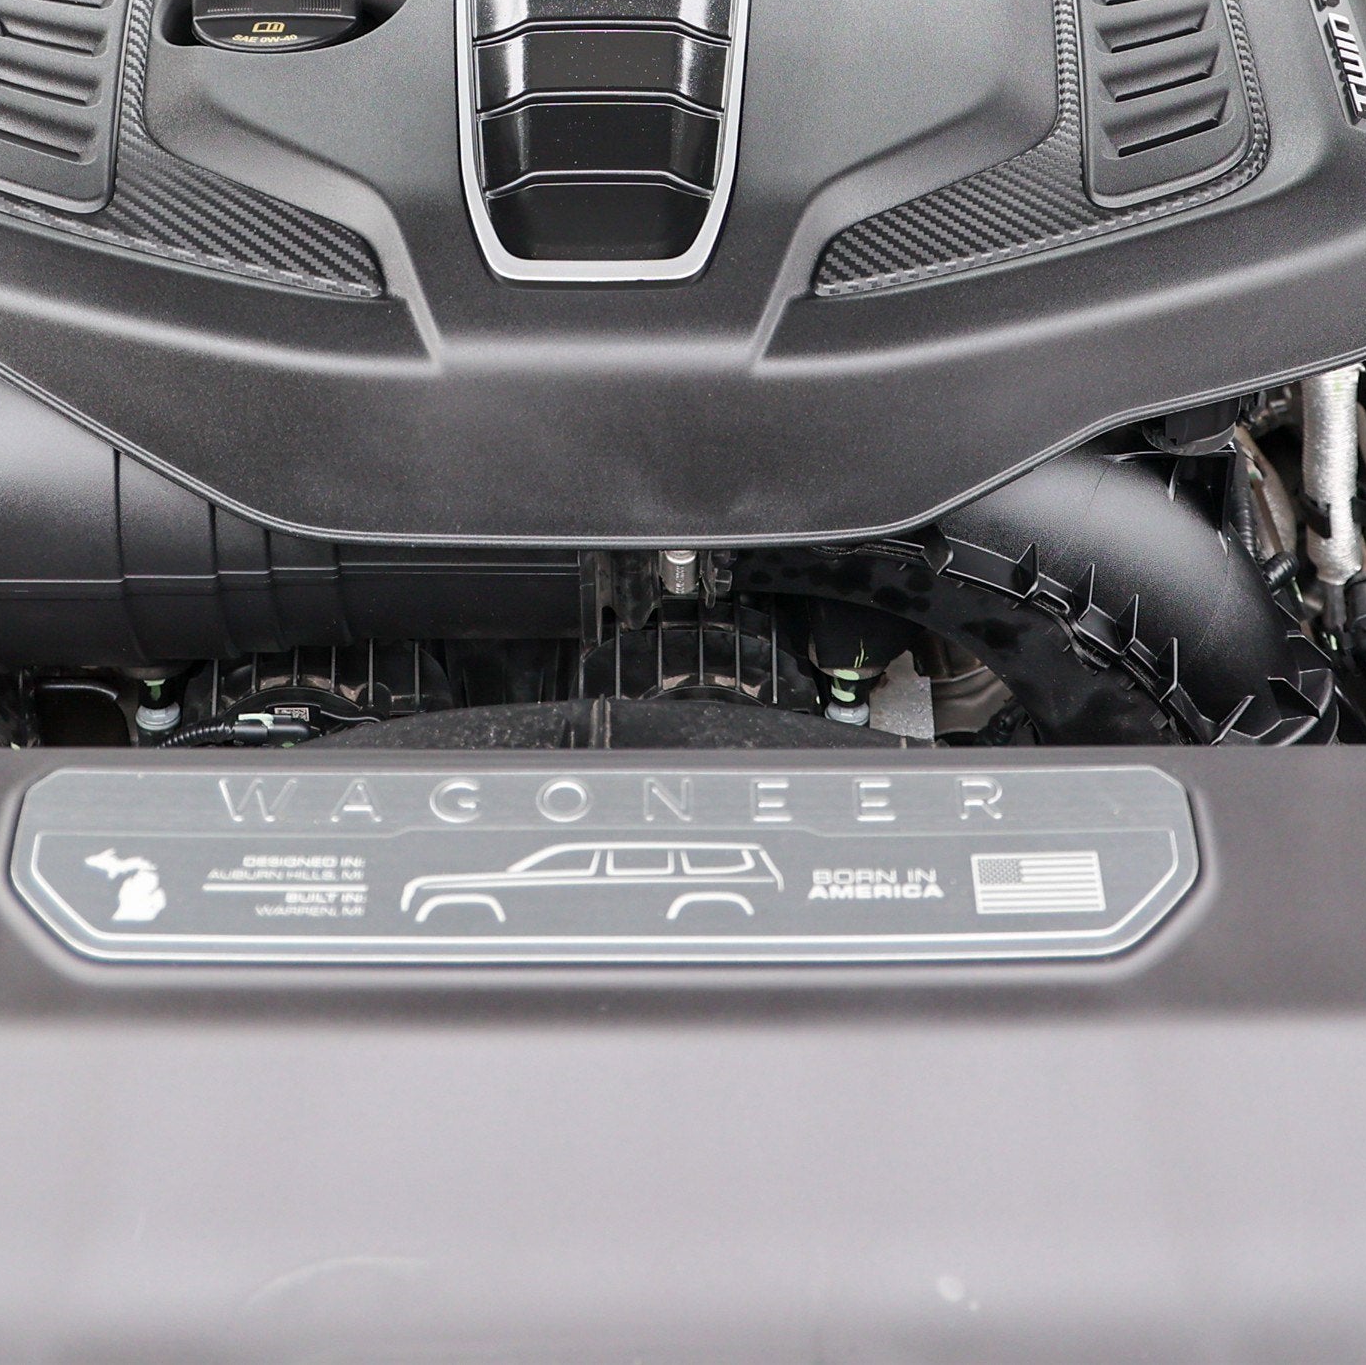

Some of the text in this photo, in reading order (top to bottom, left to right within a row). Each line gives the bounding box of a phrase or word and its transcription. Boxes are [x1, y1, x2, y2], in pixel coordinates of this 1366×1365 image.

[232, 34, 298, 43] SAE 0W-40
[218, 777, 1004, 823] WAGONEER
[242, 854, 366, 868] DESIGNED IN:
[207, 868, 284, 881] AUBURN
[812, 867, 937, 884] BORN IN
[285, 891, 367, 903] BUILT IN:
[807, 883, 945, 900] AMERICA
[255, 904, 337, 917] WARREN,
